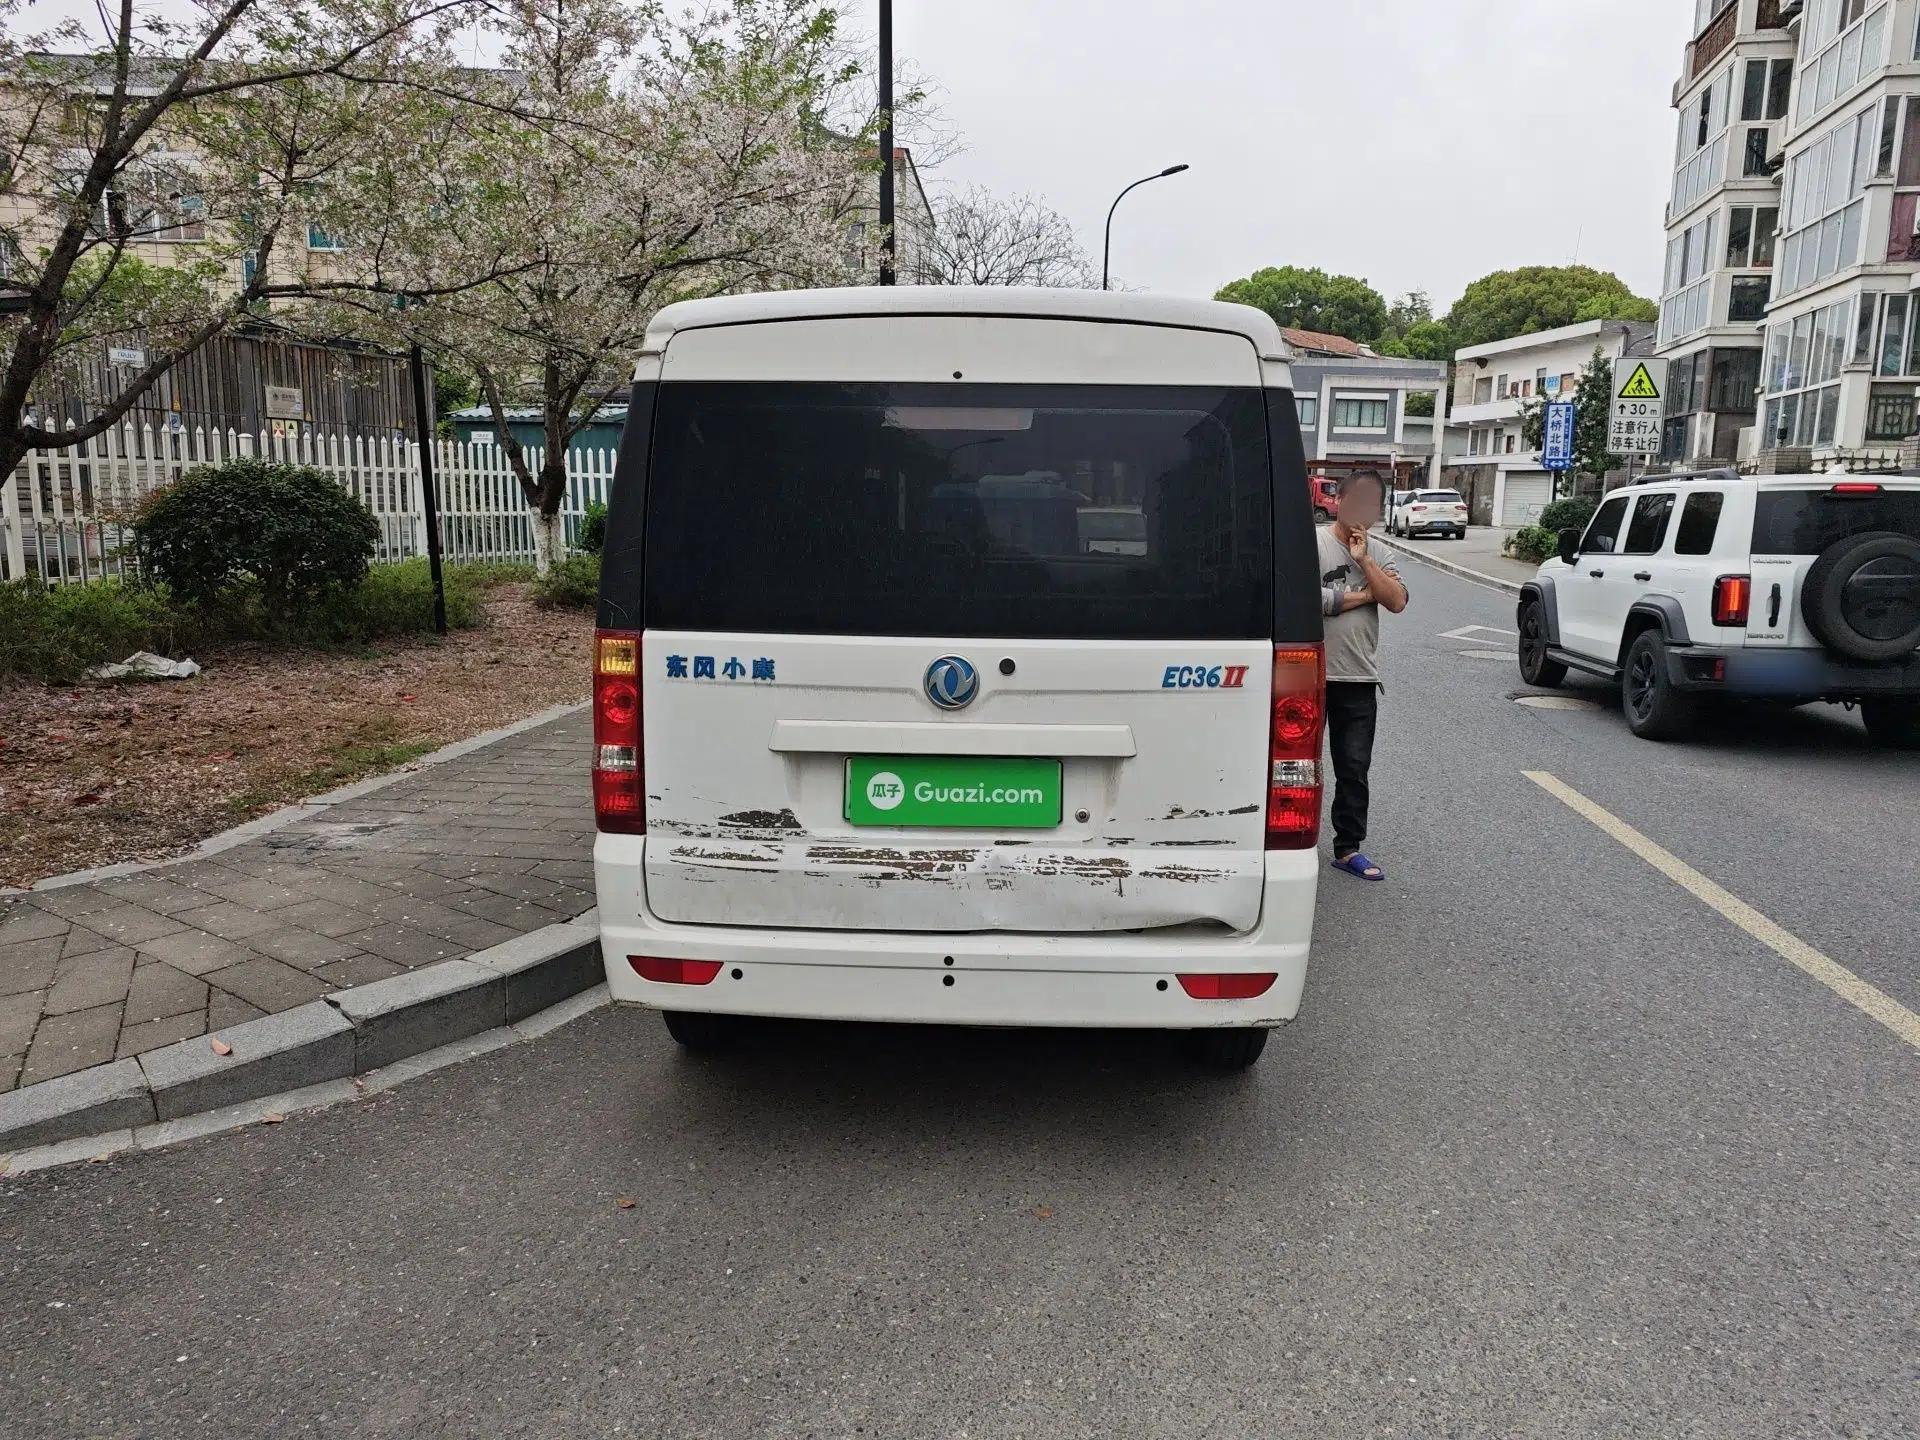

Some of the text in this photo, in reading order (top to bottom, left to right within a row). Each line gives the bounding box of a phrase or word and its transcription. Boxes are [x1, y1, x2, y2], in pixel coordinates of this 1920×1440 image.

[1630, 404, 1647, 415] 30
[1549, 406, 1563, 457] 大桥北路
[1612, 420, 1660, 434] 注意行人
[1611, 436, 1659, 451] 停车让行
[666, 655, 776, 680] 东风小康
